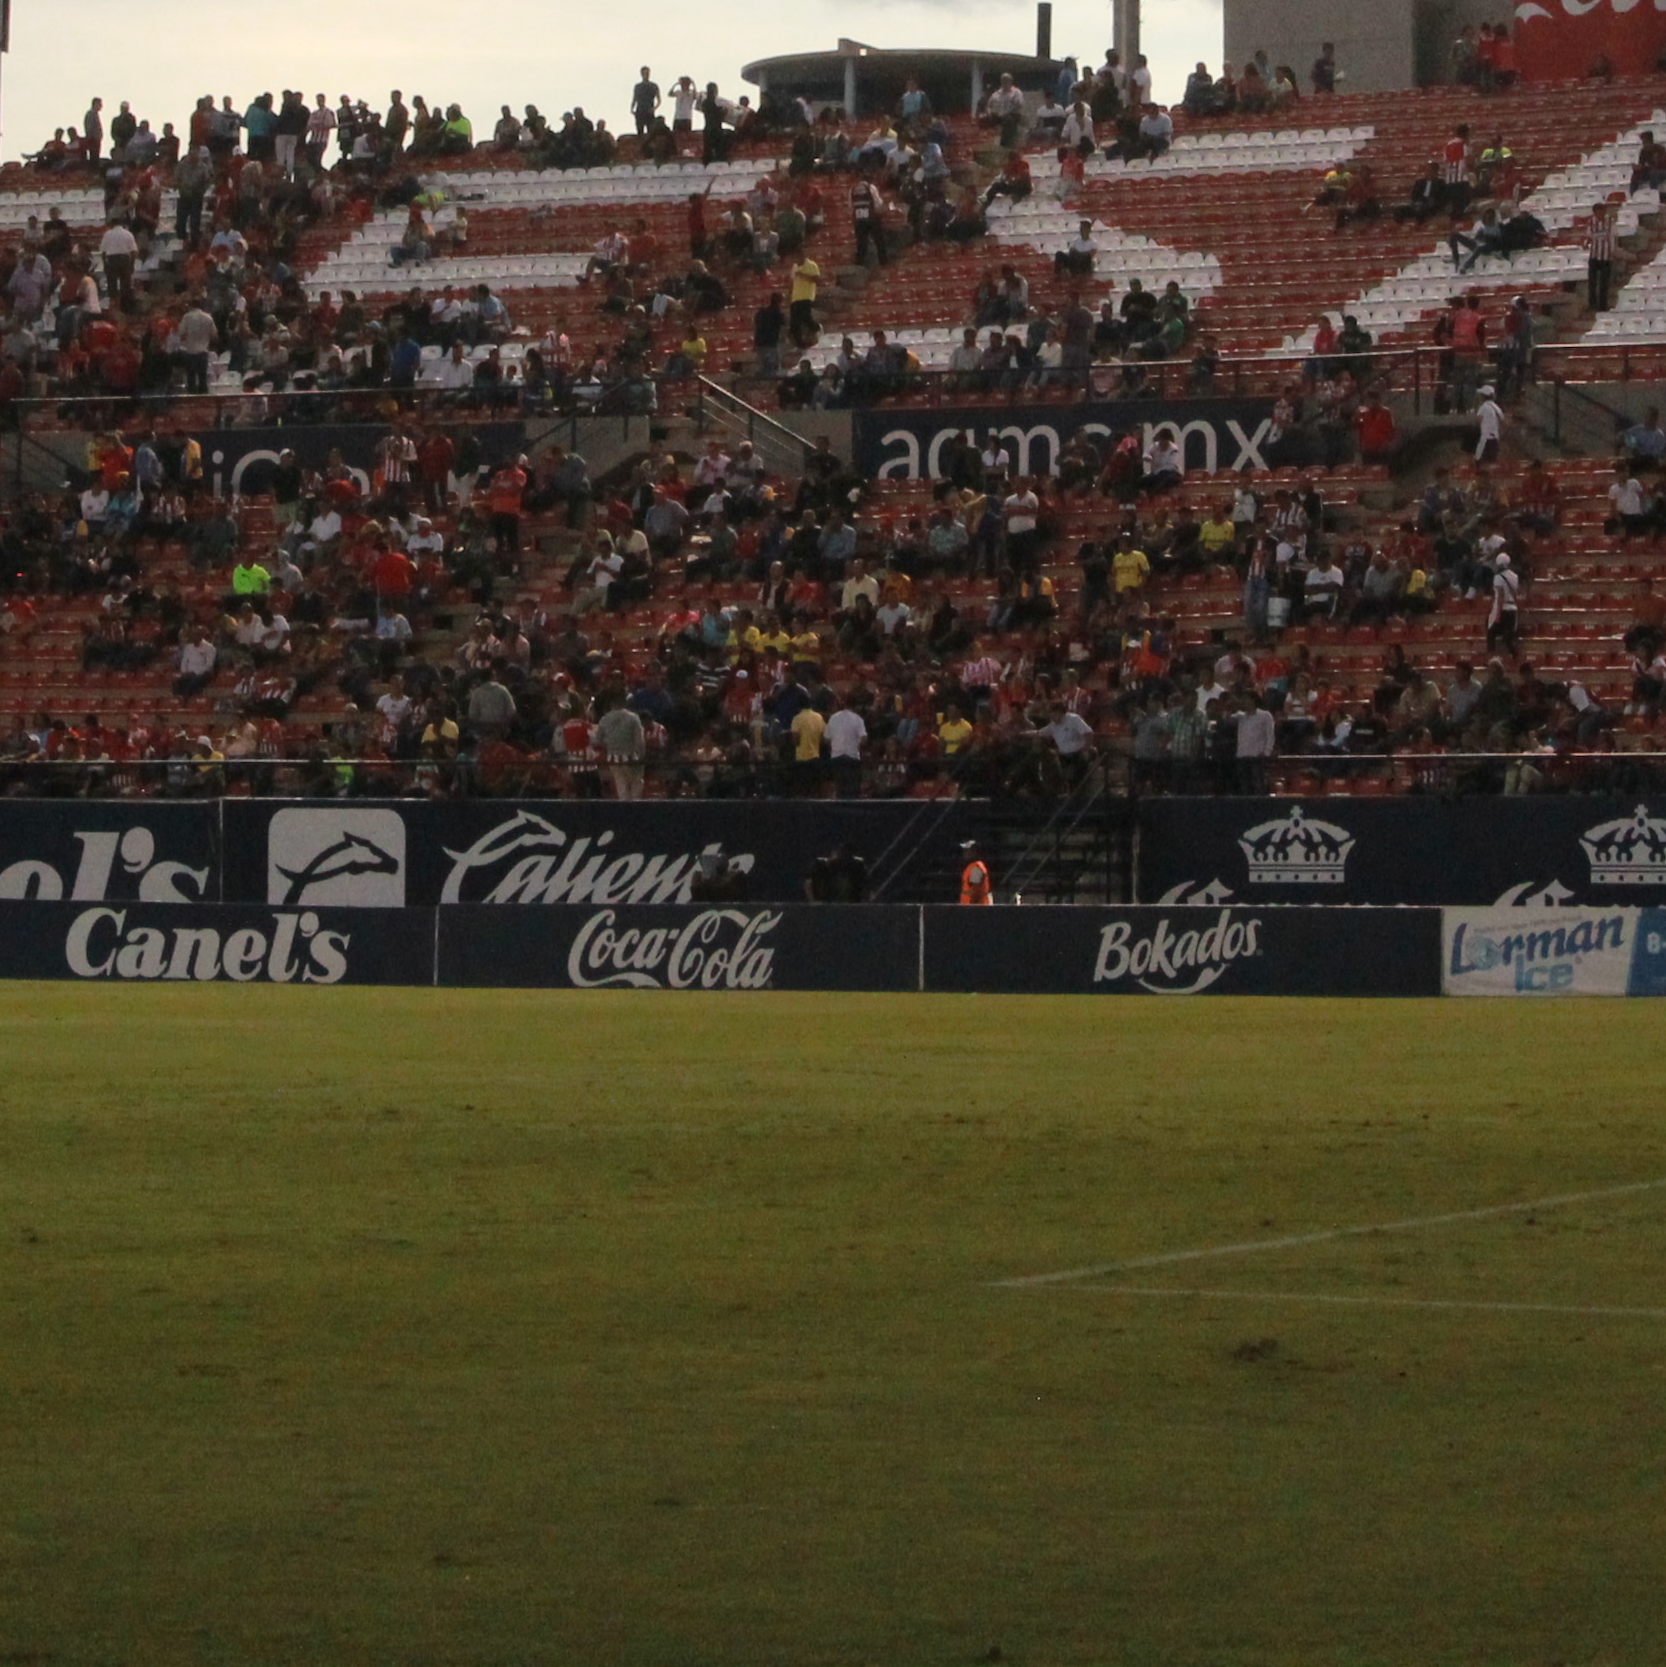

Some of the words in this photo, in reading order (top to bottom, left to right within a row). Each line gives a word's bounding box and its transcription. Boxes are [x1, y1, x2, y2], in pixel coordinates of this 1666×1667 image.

[66, 907, 351, 983] Canel's
[568, 909, 783, 988] Coca-Cola
[1094, 908, 1262, 982] Bokados
